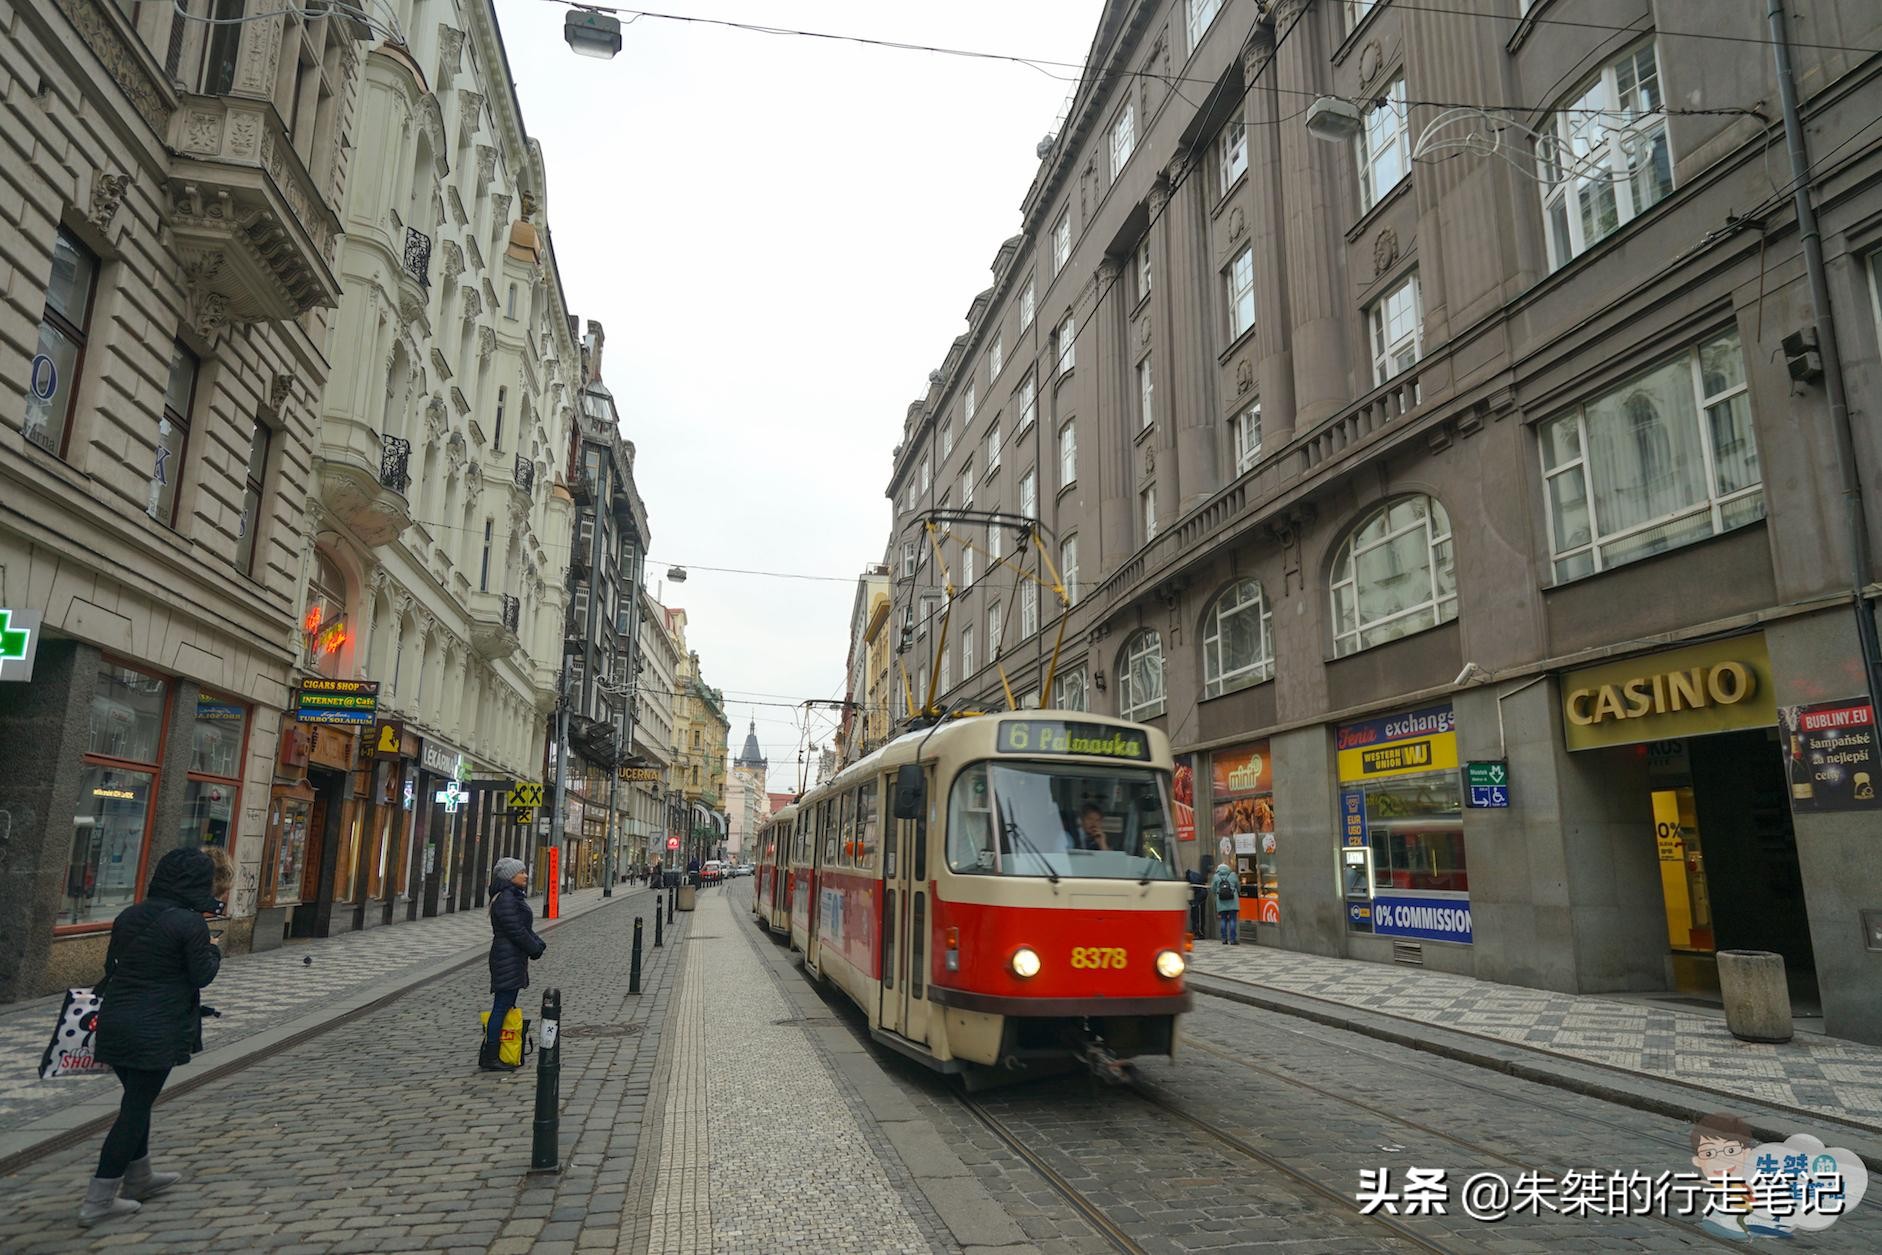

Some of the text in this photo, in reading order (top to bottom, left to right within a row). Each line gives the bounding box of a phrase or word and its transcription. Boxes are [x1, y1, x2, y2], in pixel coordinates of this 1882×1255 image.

[303, 680, 360, 691] CIGARS SHOP
[1566, 661, 1749, 726] CASINO
[300, 715, 373, 725] TURBO SOLARIUM
[1806, 709, 1868, 729] BUBLINY.EU
[1010, 723, 1140, 757] 6 Palmovka
[1810, 733, 1870, 750] šampaňské
[1364, 749, 1400, 763] WESTERN
[1827, 749, 1869, 765] nejlepší
[1375, 758, 1400, 770] UNION
[1347, 816, 1361, 824] EUR
[1348, 825, 1361, 835] USD
[1349, 836, 1362, 846] CZK
[1376, 905, 1472, 933] 0% COMMISSION
[1071, 946, 1128, 969] 8378
